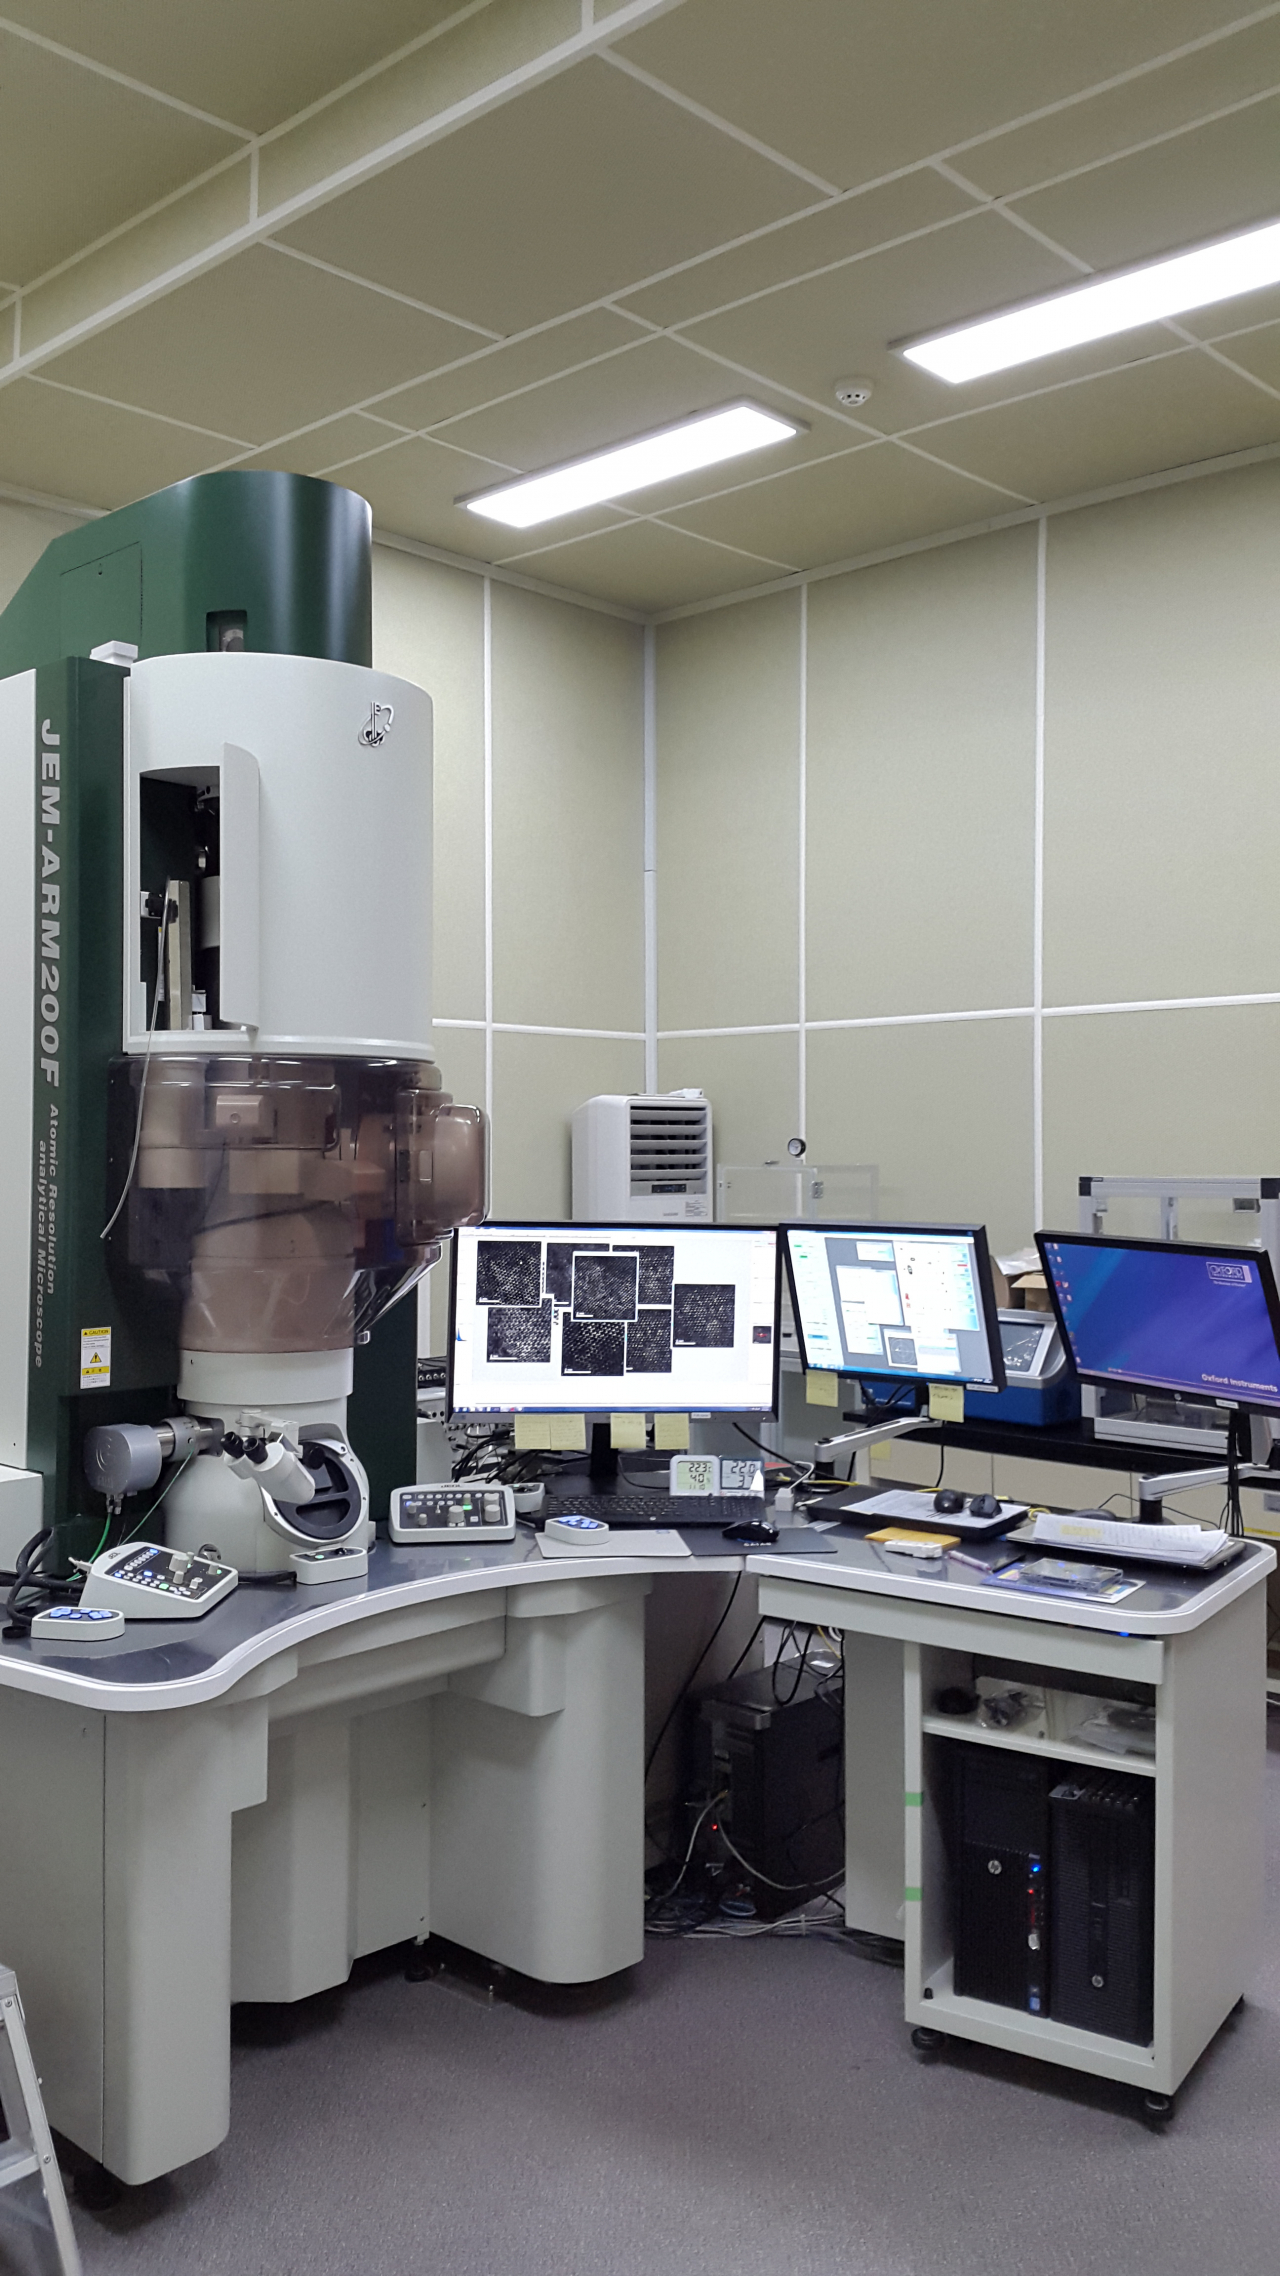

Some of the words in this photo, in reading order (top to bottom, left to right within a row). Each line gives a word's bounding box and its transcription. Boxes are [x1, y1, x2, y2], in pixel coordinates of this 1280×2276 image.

[40, 718, 61, 1088] JEM-ARM200F
[37, 1140, 48, 1243] analytical
[49, 1103, 59, 1177] Atomic
[47, 1184, 58, 1295] Resolution
[34, 1248, 46, 1368] Microscope
[1201, 1373, 1229, 1385] Oxford
[1229, 1378, 1278, 1393] Instruments
